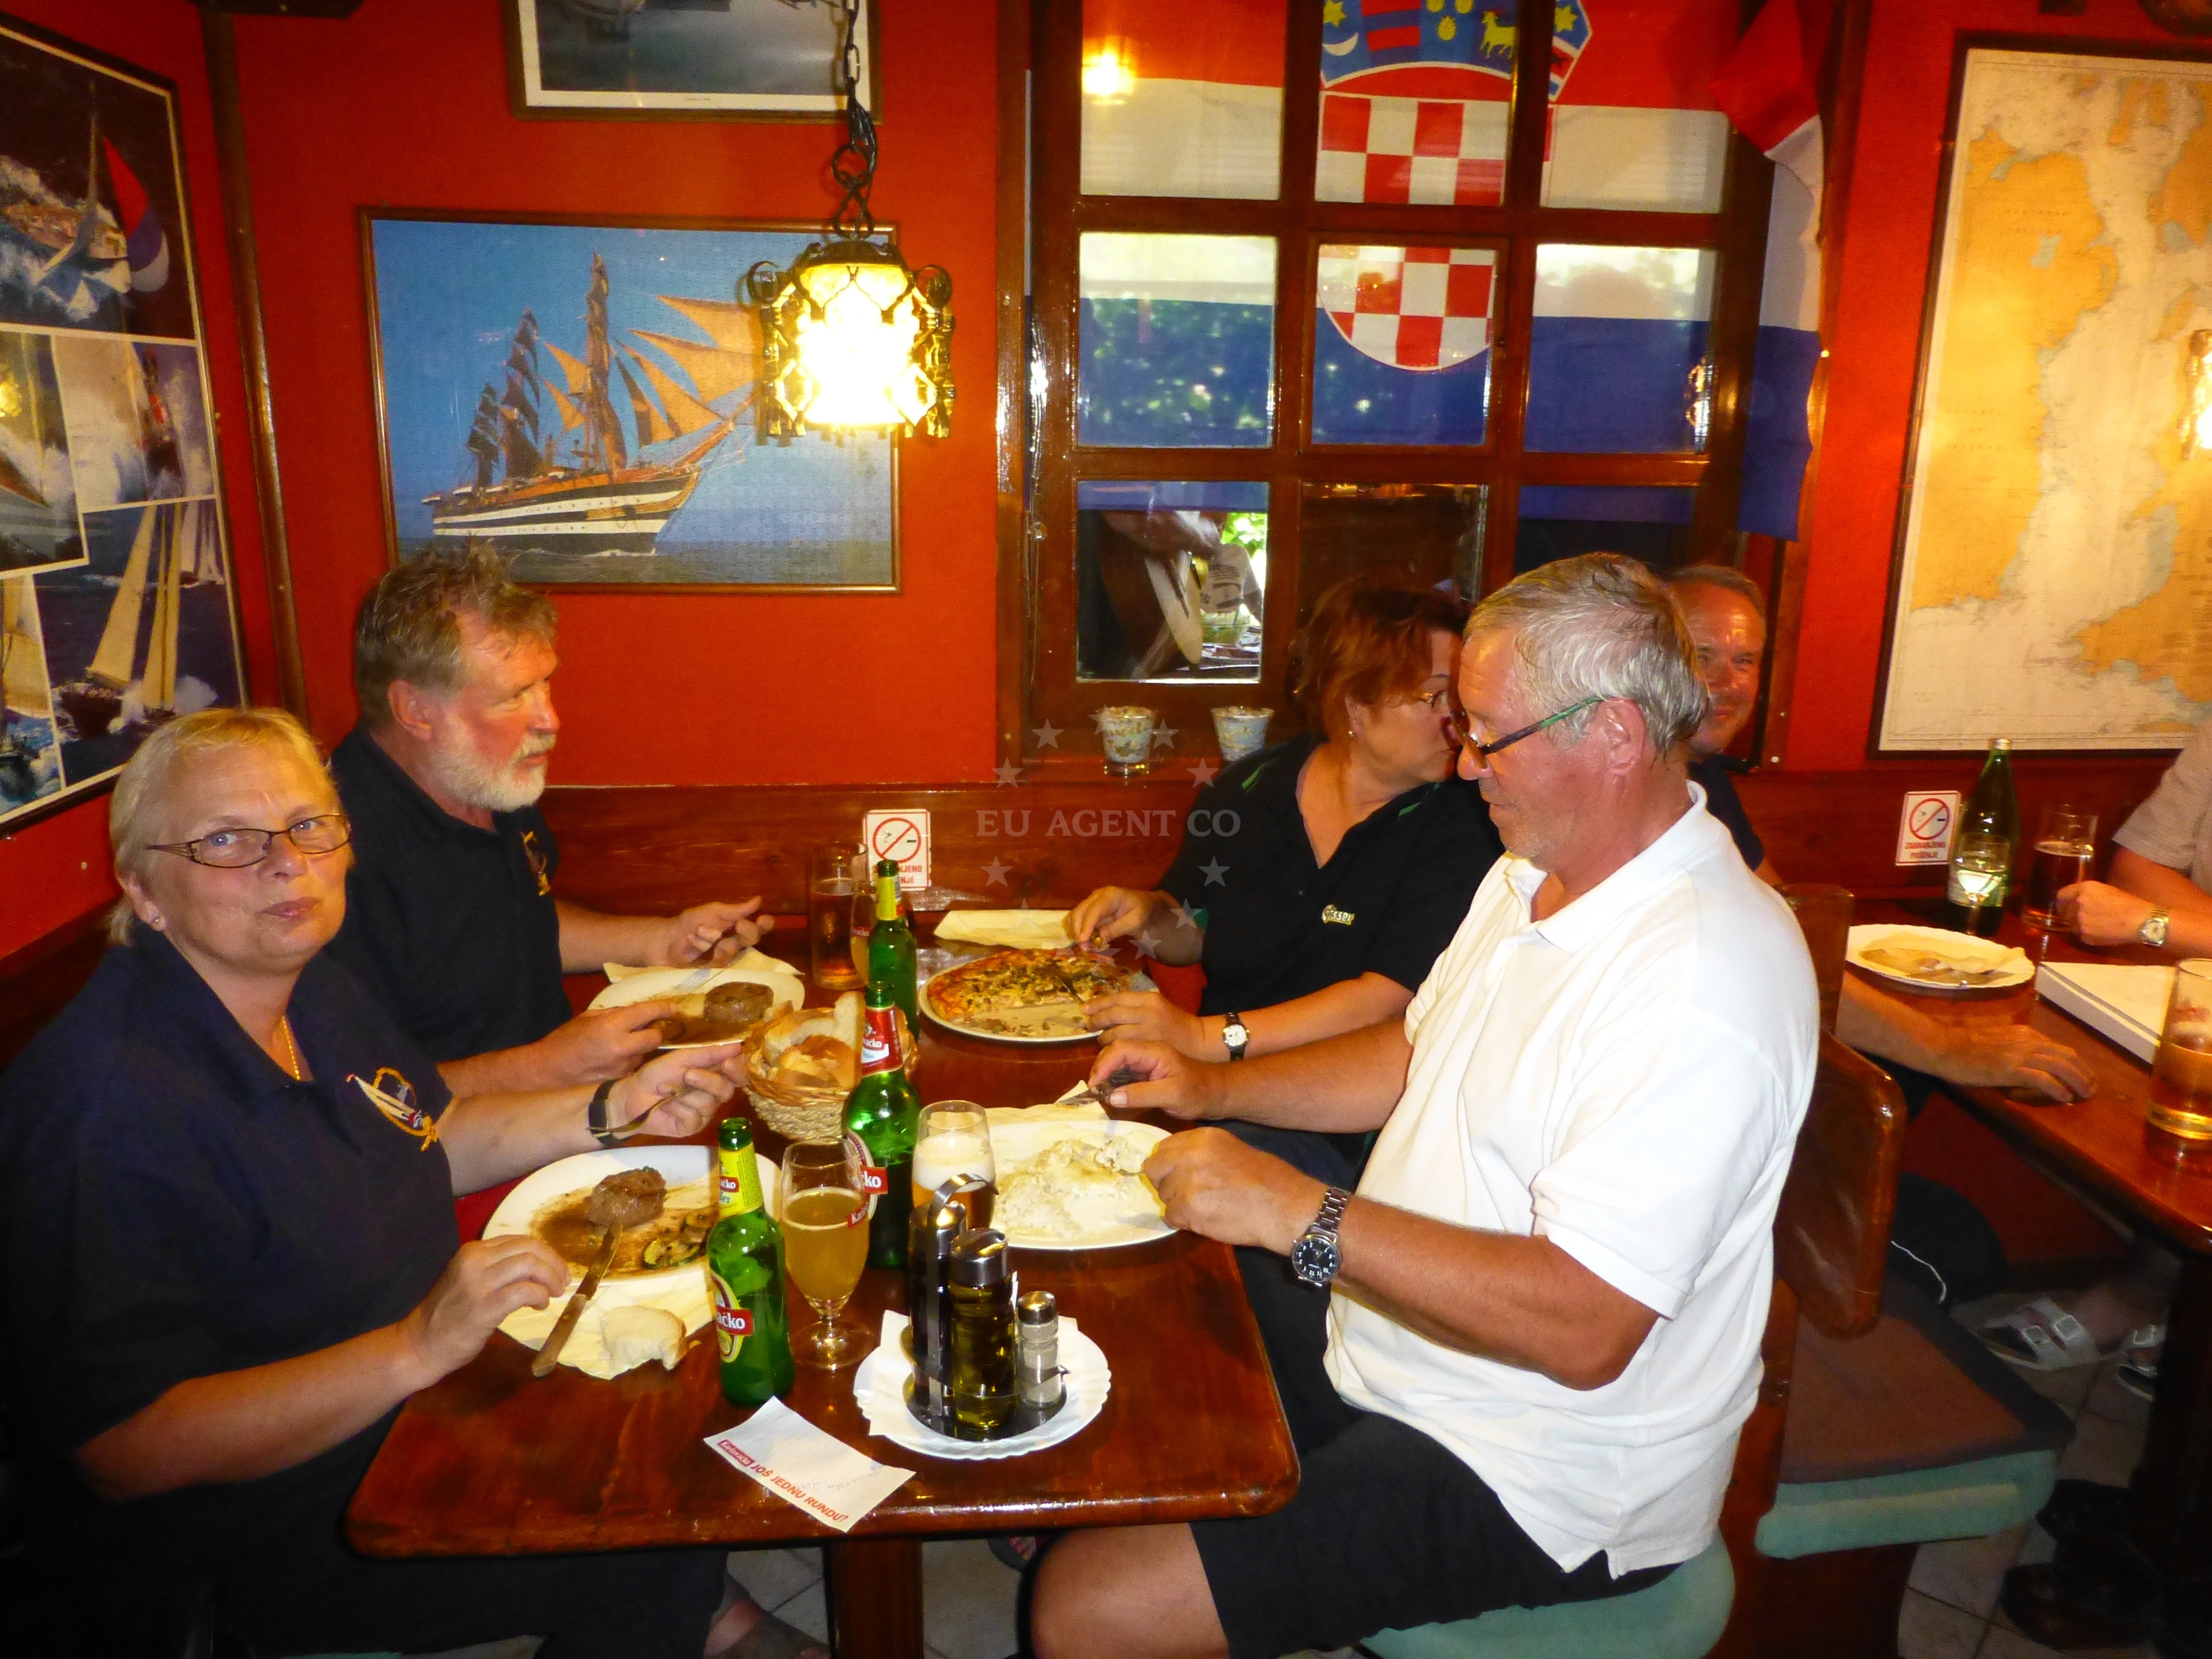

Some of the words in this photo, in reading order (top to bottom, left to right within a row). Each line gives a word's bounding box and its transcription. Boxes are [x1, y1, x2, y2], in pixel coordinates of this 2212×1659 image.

[750, 1464, 774, 1477] JOŠ
[770, 1476, 806, 1498] JEDNU
[803, 1496, 849, 1522] RUNDU?
